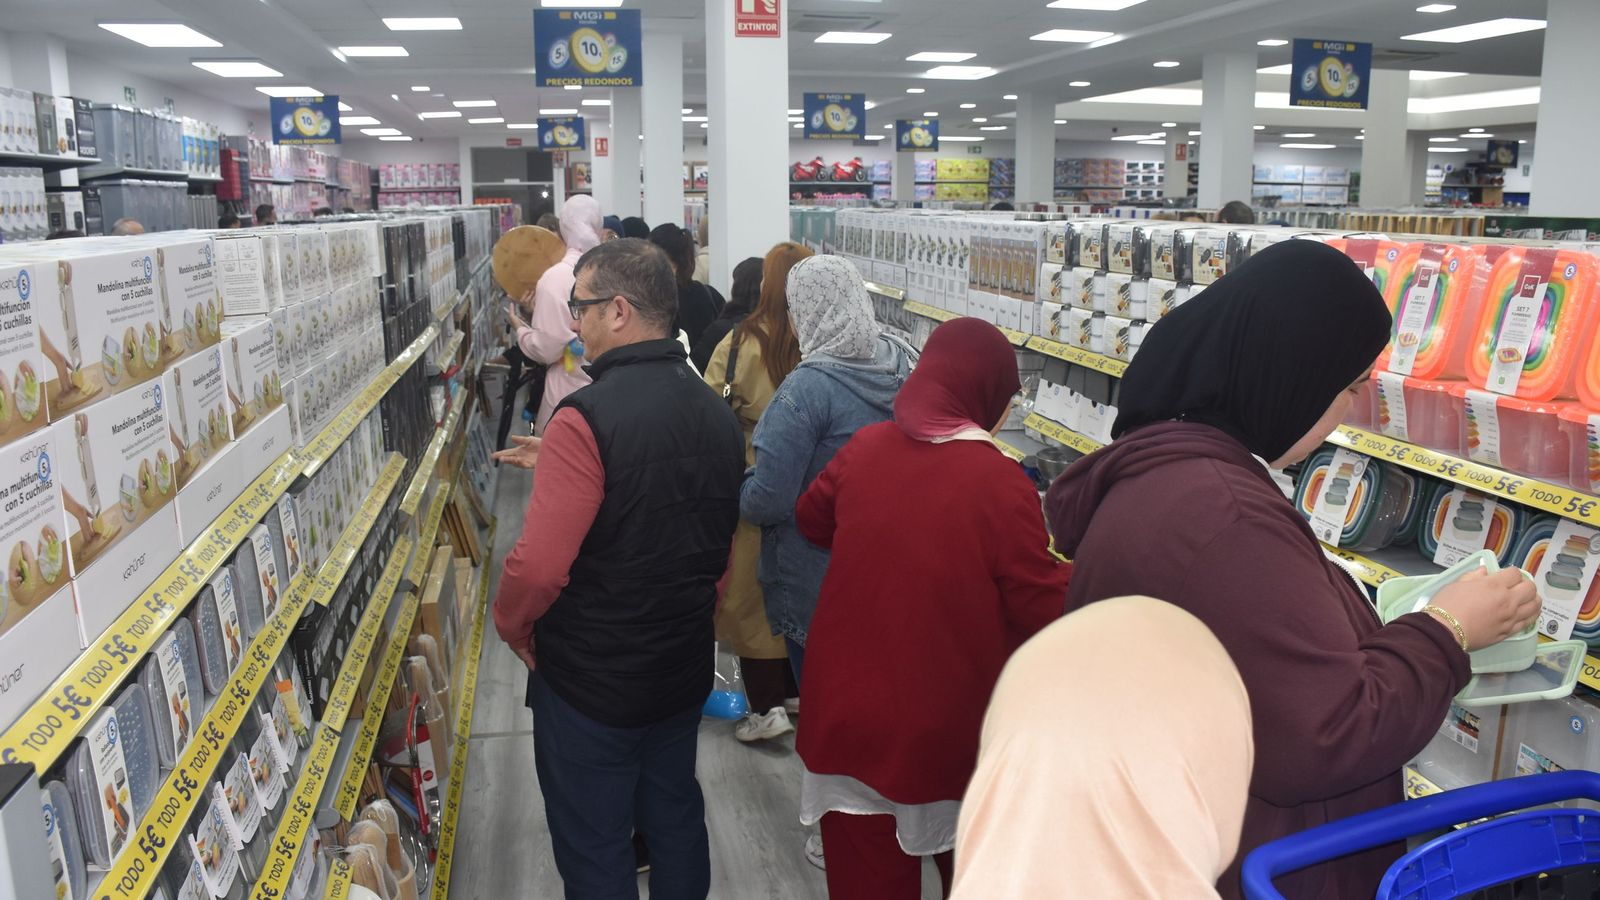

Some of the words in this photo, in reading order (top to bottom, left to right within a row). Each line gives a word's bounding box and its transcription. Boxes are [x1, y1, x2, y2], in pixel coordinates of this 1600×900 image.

[737, 22, 777, 31] EXTINTOR
[546, 77, 582, 86] PRECIOS
[584, 77, 633, 86] REDONDOS
[97, 280, 124, 294] Mandolina
[121, 293, 129, 302] con
[130, 291, 135, 300] 5
[134, 286, 153, 298] cuchillas
[4, 314, 32, 330] cuchillas
[1096, 358, 1108, 370] 5€
[111, 417, 136, 436] Mandolina
[134, 426, 142, 437] con
[142, 423, 147, 432] 5
[146, 413, 163, 429] cuchillas
[1052, 427, 1064, 439] 5€
[1071, 436, 1084, 448] 5€
[10, 472, 40, 494] multifun
[1363, 438, 1387, 451] TODO
[1386, 444, 1410, 461] 5€
[1411, 453, 1437, 467] TODO
[1436, 459, 1464, 477] 5€
[1464, 468, 1493, 484] TODO
[1493, 475, 1524, 496] 5€
[1529, 488, 1563, 505] TODO
[1562, 496, 1597, 518] 5€
[5, 499, 19, 513] con
[19, 492, 24, 505] 5
[25, 479, 53, 501] cuchillas
[22, 715, 63, 752] TODO
[51, 685, 92, 721] 5€
[80, 659, 114, 690] TODO
[103, 634, 138, 665] 5€
[126, 614, 154, 640] TODO
[144, 592, 175, 620] 5€
[164, 575, 188, 600] TODO
[180, 557, 205, 583] 5€
[197, 543, 217, 565] TODO
[212, 527, 232, 553] 5€
[224, 516, 242, 537] TODO
[234, 503, 254, 526] 5€
[246, 495, 262, 512] TODO
[255, 483, 273, 502] 5€
[332, 696, 347, 712] 5€
[342, 671, 356, 686] 5€
[352, 648, 365, 663] 5€
[116, 858, 145, 898] TODO
[138, 824, 166, 863] 5€
[157, 797, 180, 829] TODO
[173, 769, 198, 802] 5€
[189, 745, 210, 773] TODO
[202, 721, 224, 750] 5€
[219, 700, 238, 725] TODO
[230, 679, 250, 706] 5€
[243, 662, 259, 684] TODO
[252, 644, 270, 668] 5€
[263, 630, 278, 650] TODO
[272, 615, 288, 637] 5€
[281, 603, 294, 620] TODO
[288, 588, 303, 609] 5€
[321, 727, 337, 747] 5€
[362, 726, 374, 742] 5€
[316, 744, 330, 763] TODO
[353, 752, 366, 769] 5€
[308, 760, 325, 780] 5€
[350, 767, 360, 783] TODO
[303, 777, 317, 798] TODO
[343, 780, 357, 799] 5€
[1406, 775, 1430, 797] 5€
[293, 796, 311, 818] 5€
[339, 796, 351, 815] TODO
[286, 815, 302, 838] TODO
[276, 835, 296, 860] 5€
[269, 857, 285, 883] TODO
[334, 859, 350, 880] 5€
[331, 880, 344, 899] TODO
